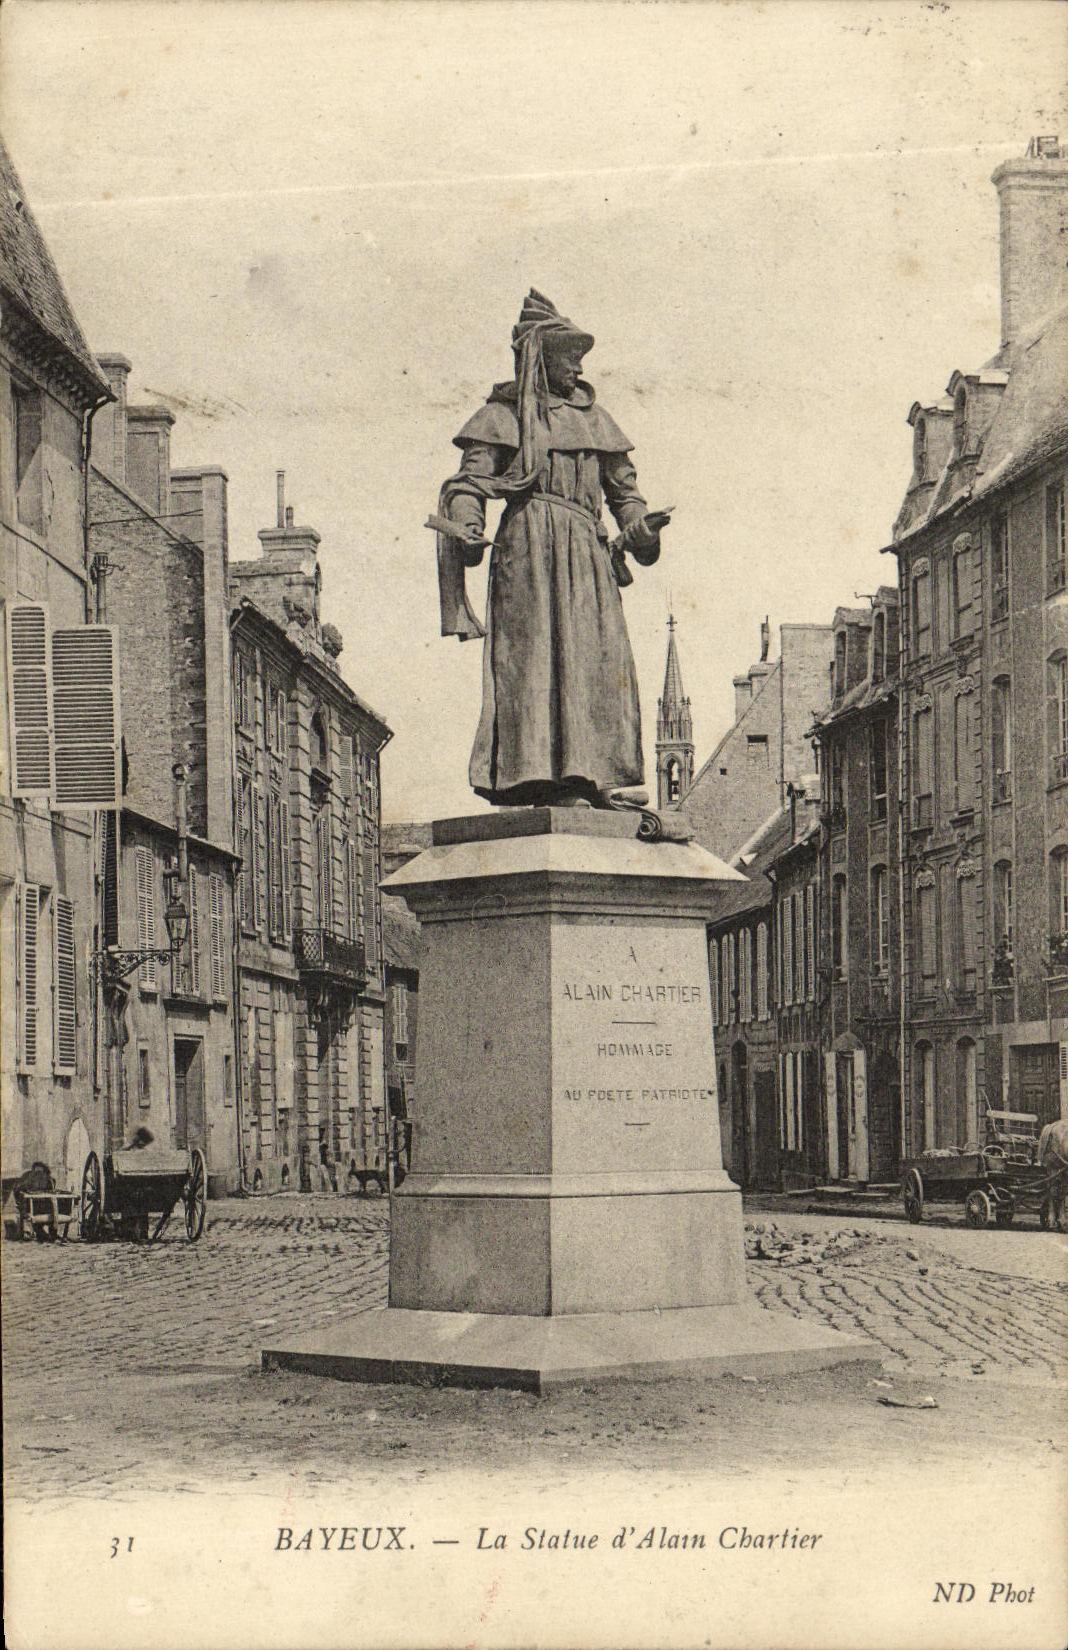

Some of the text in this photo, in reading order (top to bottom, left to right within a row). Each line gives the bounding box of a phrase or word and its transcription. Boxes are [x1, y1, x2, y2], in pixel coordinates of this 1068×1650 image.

[562, 984, 701, 1003] ALAIN CHARTIER
[597, 1043, 673, 1057] HOMMAGE
[564, 1088, 708, 1101] AU POETE PATRIOTE
